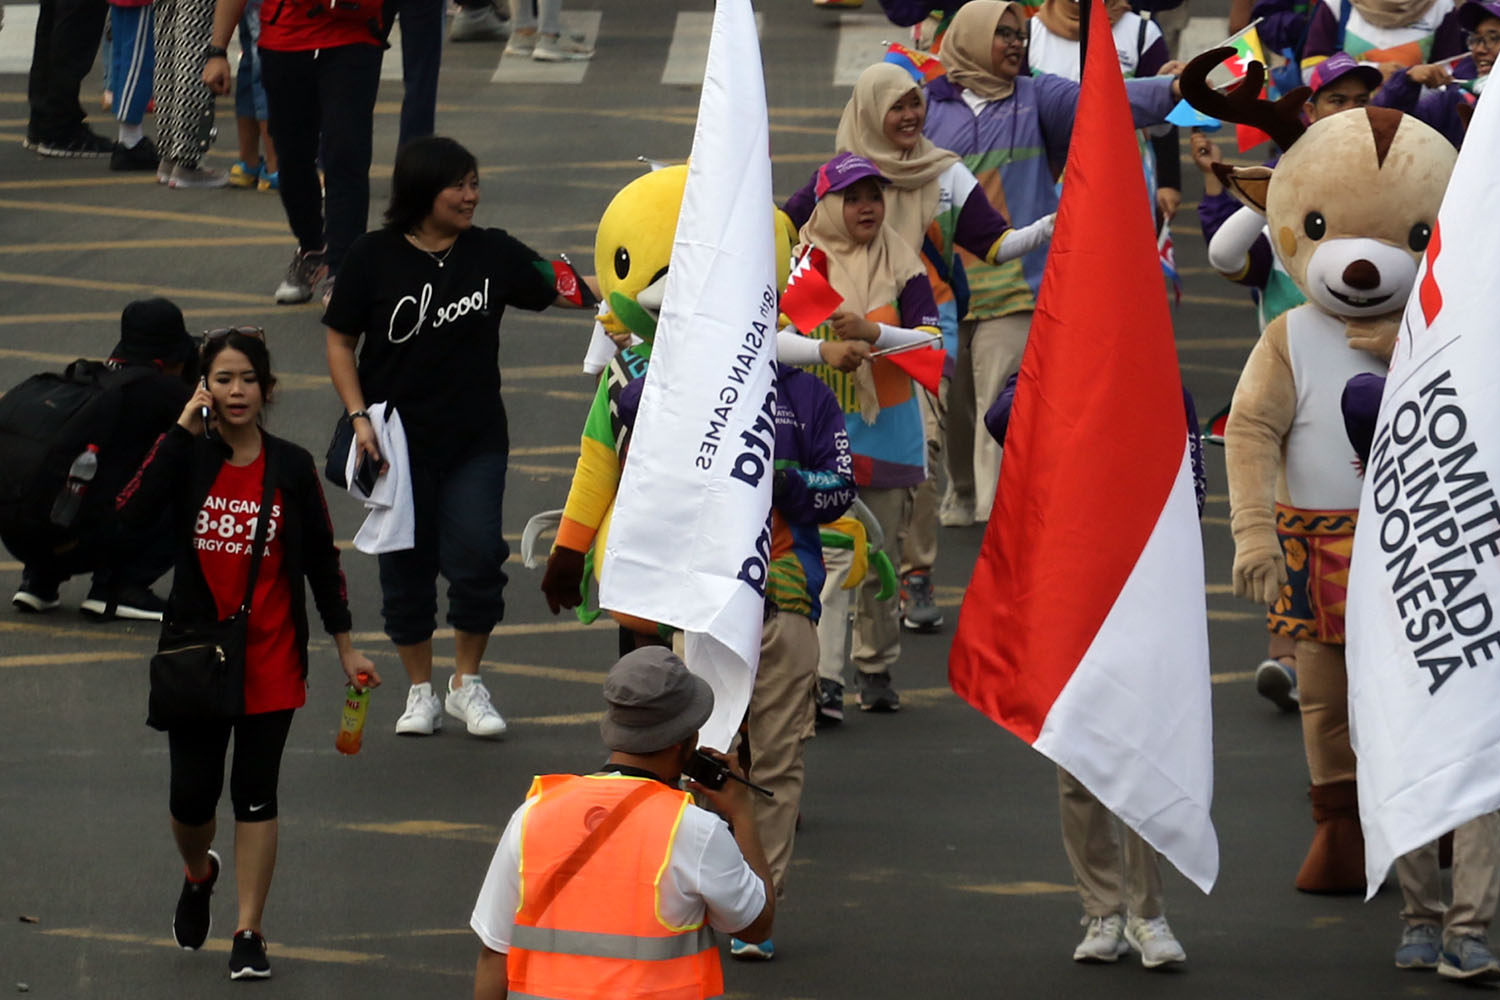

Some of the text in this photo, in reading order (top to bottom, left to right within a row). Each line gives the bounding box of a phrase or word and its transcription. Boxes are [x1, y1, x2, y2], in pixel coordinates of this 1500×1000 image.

[203, 495, 281, 518] AN GAMS
[225, 541, 243, 554] OF
[243, 543, 270, 557] AA
[1372, 421, 1464, 696] INDONESIA
